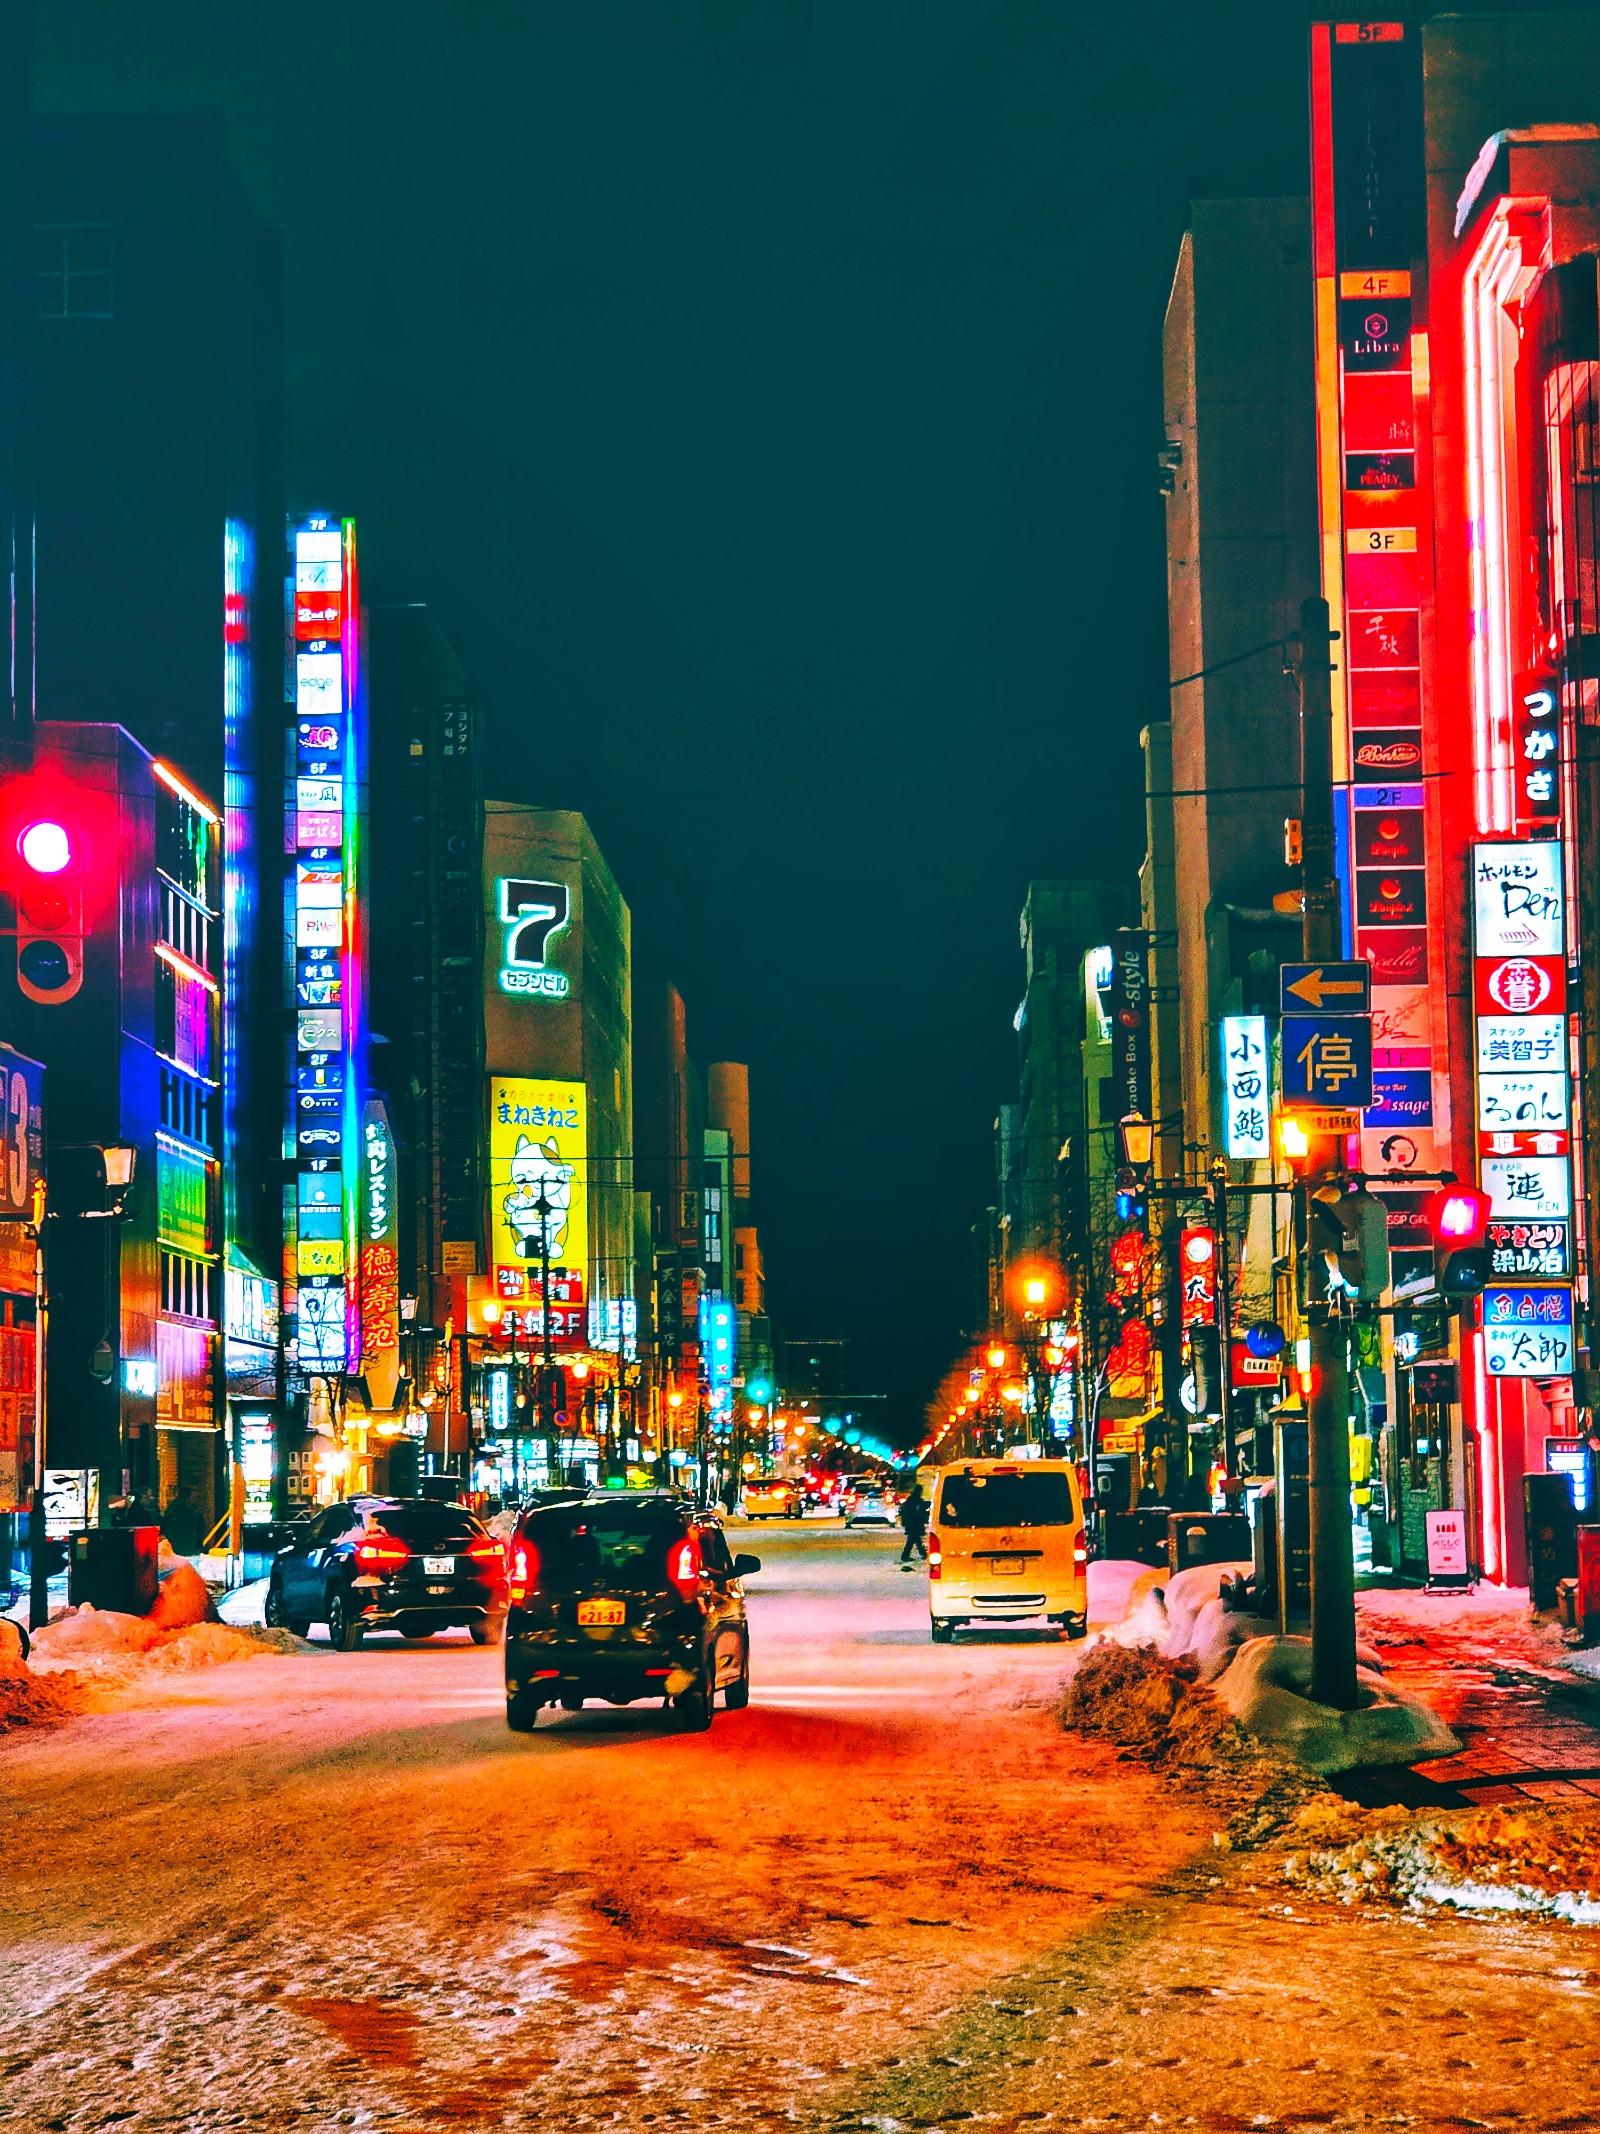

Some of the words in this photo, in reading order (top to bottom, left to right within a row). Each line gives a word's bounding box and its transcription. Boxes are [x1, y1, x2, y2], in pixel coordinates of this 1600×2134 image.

[1357, 26, 1383, 41] 5F
[1363, 276, 1388, 293] 4F
[1354, 340, 1400, 353] Libra
[310, 519, 327, 531] 7F
[1369, 532, 1395, 549] 3F
[310, 641, 326, 652] 6F
[1524, 691, 1554, 801] つかさ
[310, 763, 327, 774] 5F
[1376, 788, 1402, 806] 2F
[311, 848, 328, 859] 4F
[1478, 862, 1538, 882] ホルモン
[1500, 881, 1561, 920] Den
[503, 879, 568, 967] 7
[311, 949, 328, 960] 3F
[506, 971, 568, 992] セブンビル
[1489, 1027, 1526, 1036] スナック
[1126, 1035, 1136, 1062] Box
[1489, 1040, 1555, 1061] 美智子
[311, 1054, 328, 1065] 2F
[1297, 1033, 1357, 1091] 停
[1231, 1034, 1265, 1142] 小西鮨
[1503, 1083, 1534, 1091] スナック
[497, 1104, 580, 1128] まねきねこ
[311, 1159, 328, 1171] 1F
[1489, 1225, 1563, 1248] やきとり
[1492, 1249, 1563, 1273] 梁山泊
[1490, 1293, 1565, 1321] 魚自慢
[1512, 1332, 1568, 1372] 太郎
